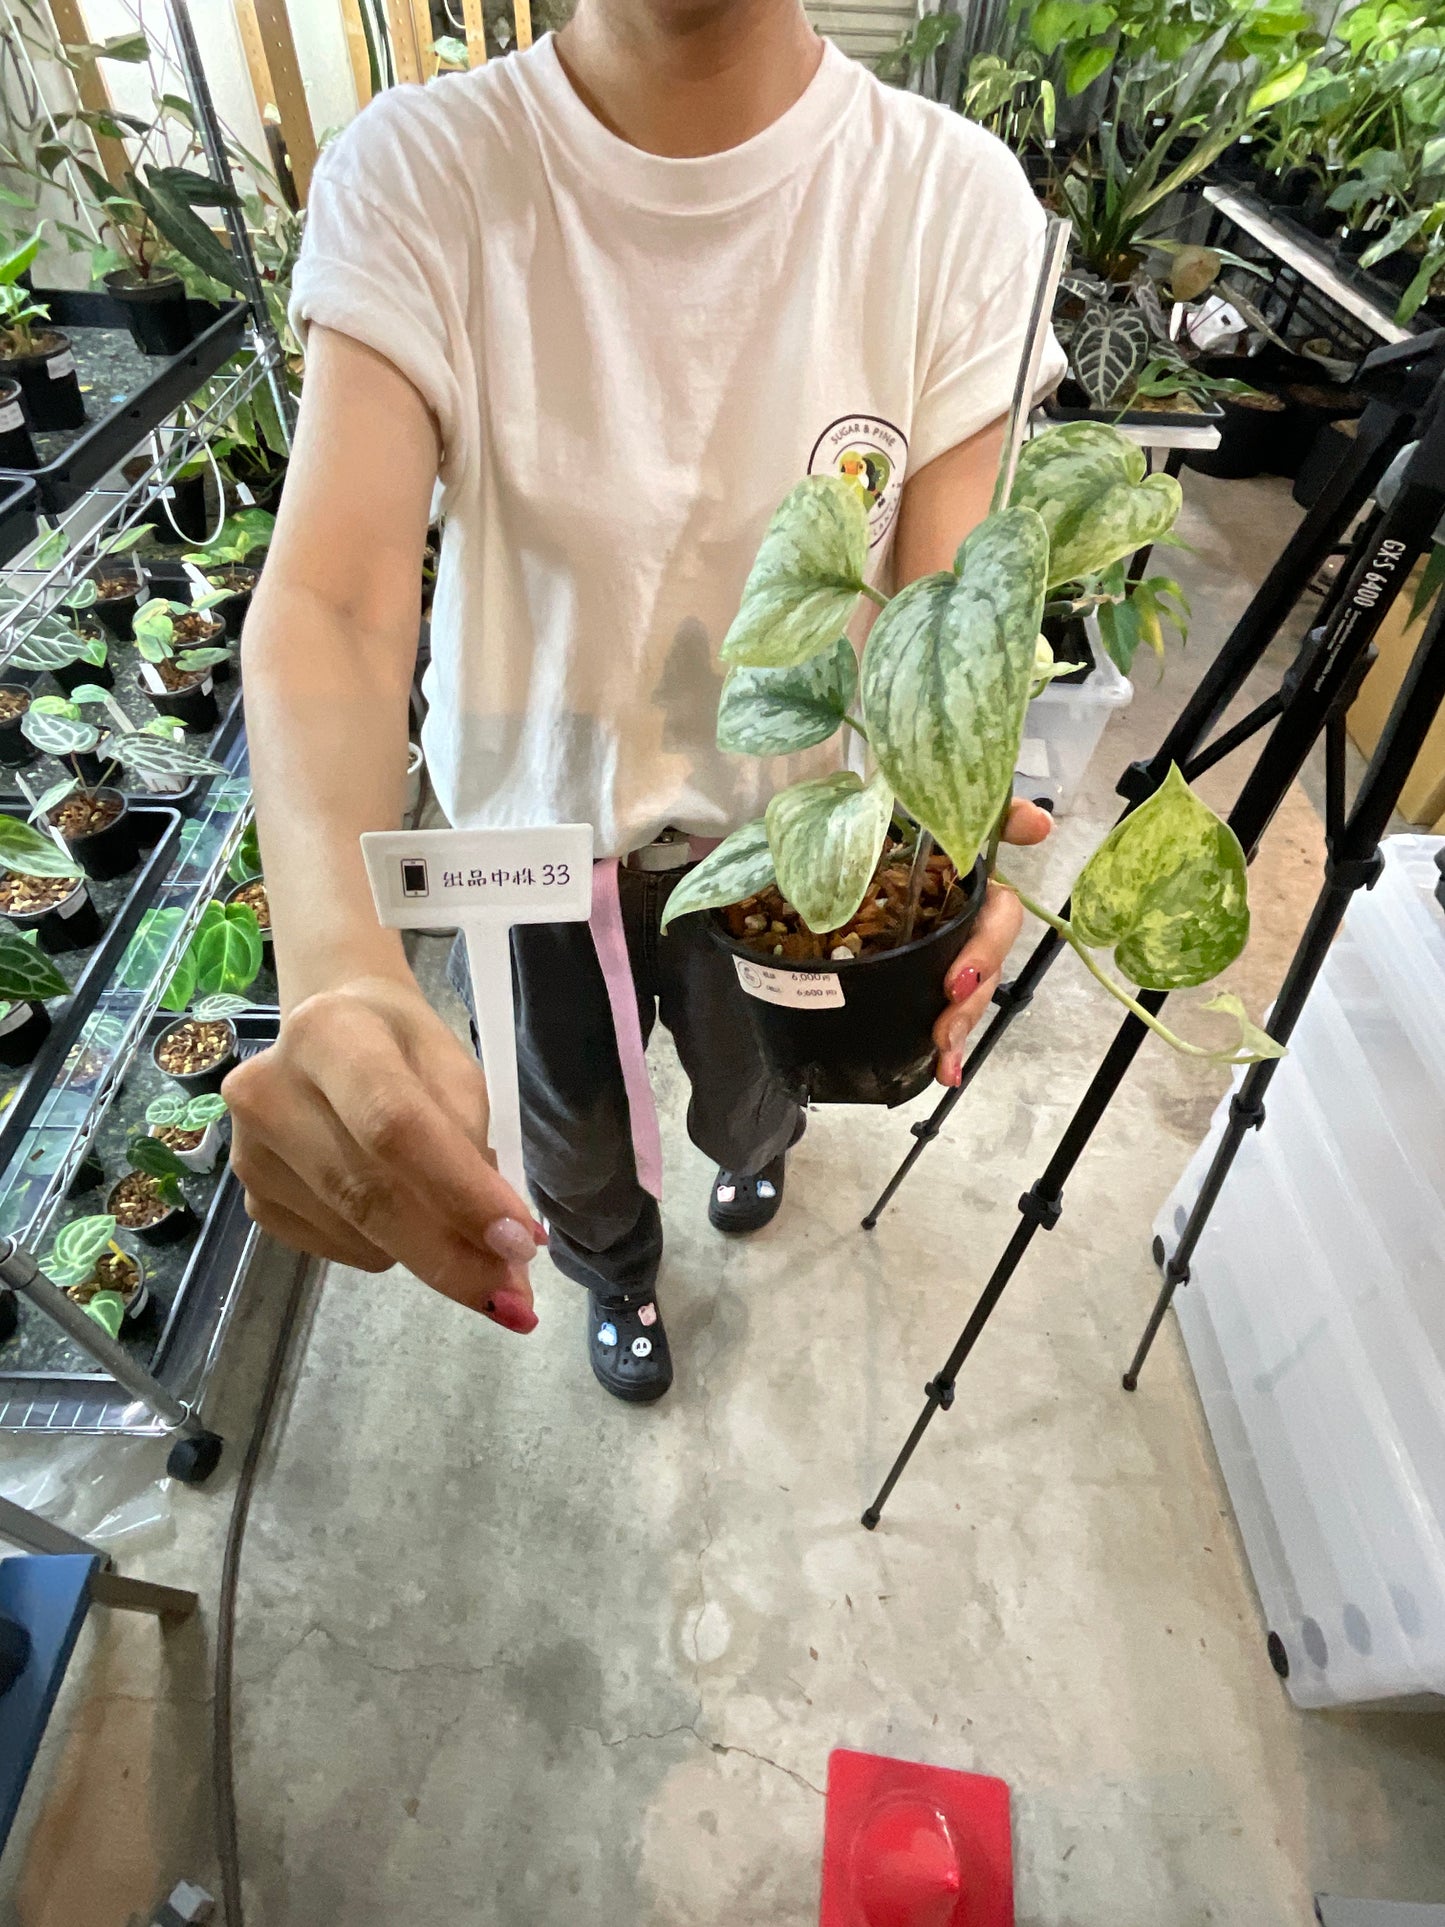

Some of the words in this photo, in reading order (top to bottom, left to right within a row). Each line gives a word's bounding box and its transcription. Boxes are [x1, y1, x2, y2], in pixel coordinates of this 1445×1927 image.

[831, 423, 860, 445] SUGAR
[863, 424, 870, 434] &
[872, 427, 897, 447] PINE
[1372, 539, 1407, 571] GX-S
[1353, 572, 1388, 608] 6400
